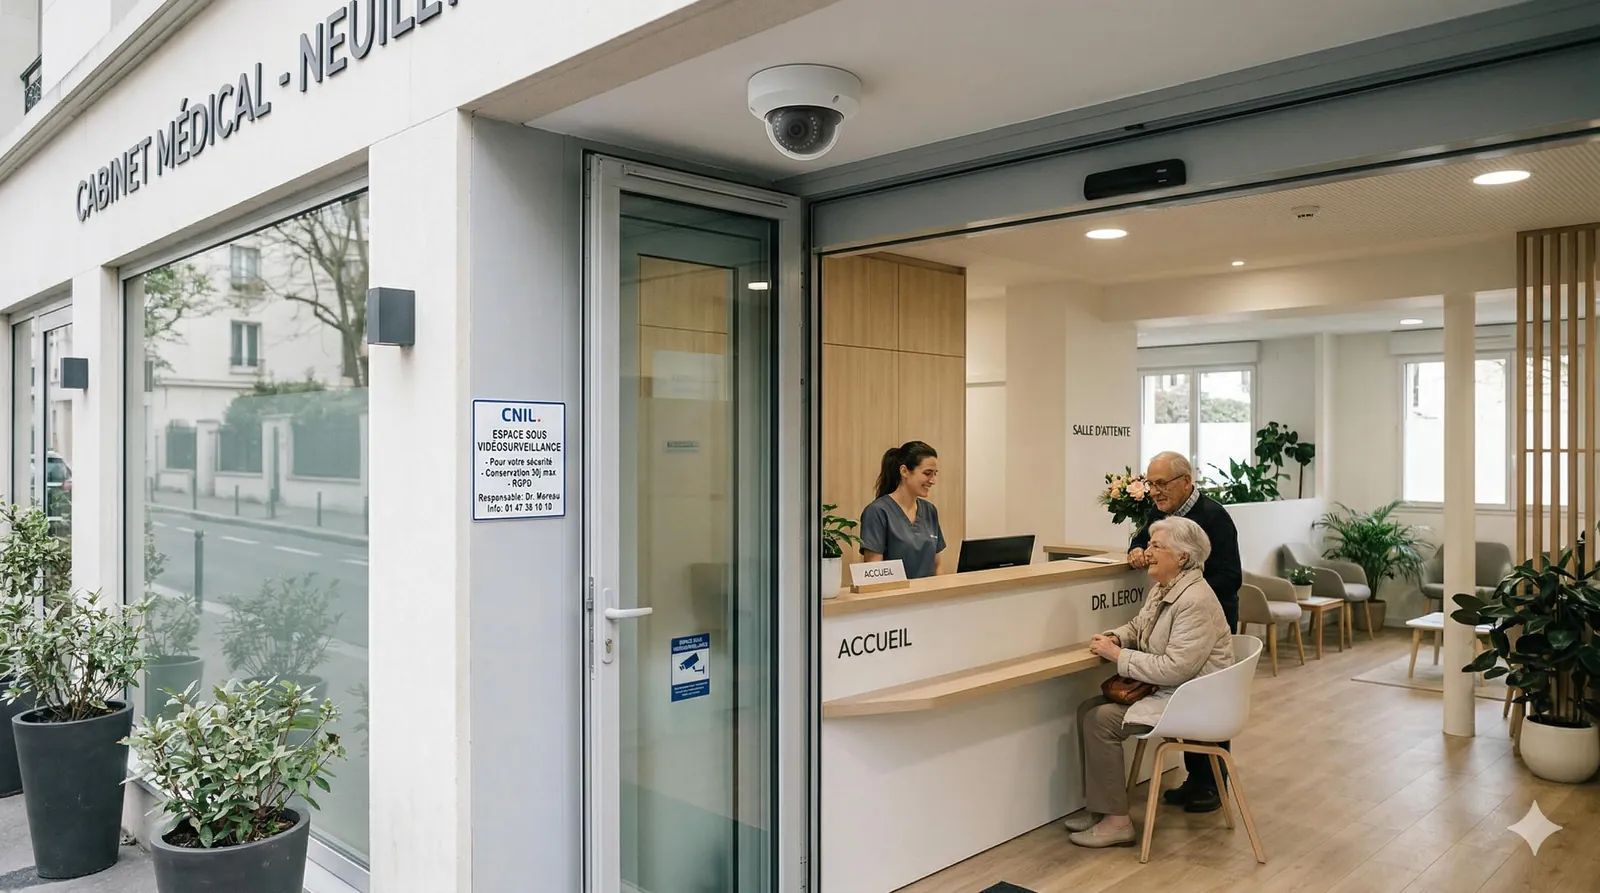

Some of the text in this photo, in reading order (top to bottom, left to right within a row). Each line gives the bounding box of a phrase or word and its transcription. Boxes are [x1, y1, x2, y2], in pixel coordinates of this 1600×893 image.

[76, 0, 458, 222] CABINET MÉDICAL - NEUIL
[492, 429, 548, 440] ESPACE SOUS
[1072, 424, 1131, 437] SALLE D'ATTENTE
[477, 440, 562, 452] VIDÉOSURVEILLANCE
[489, 457, 506, 466] Pour
[507, 457, 525, 466] votre
[485, 468, 530, 477] Conservation
[525, 492, 535, 501] Dr.
[487, 504, 504, 513] Info:
[504, 503, 513, 512] 01
[514, 503, 523, 512] 47
[534, 502, 543, 511] 10
[1091, 587, 1145, 611] DR. LEROY
[837, 627, 913, 659] ACCUEIL
